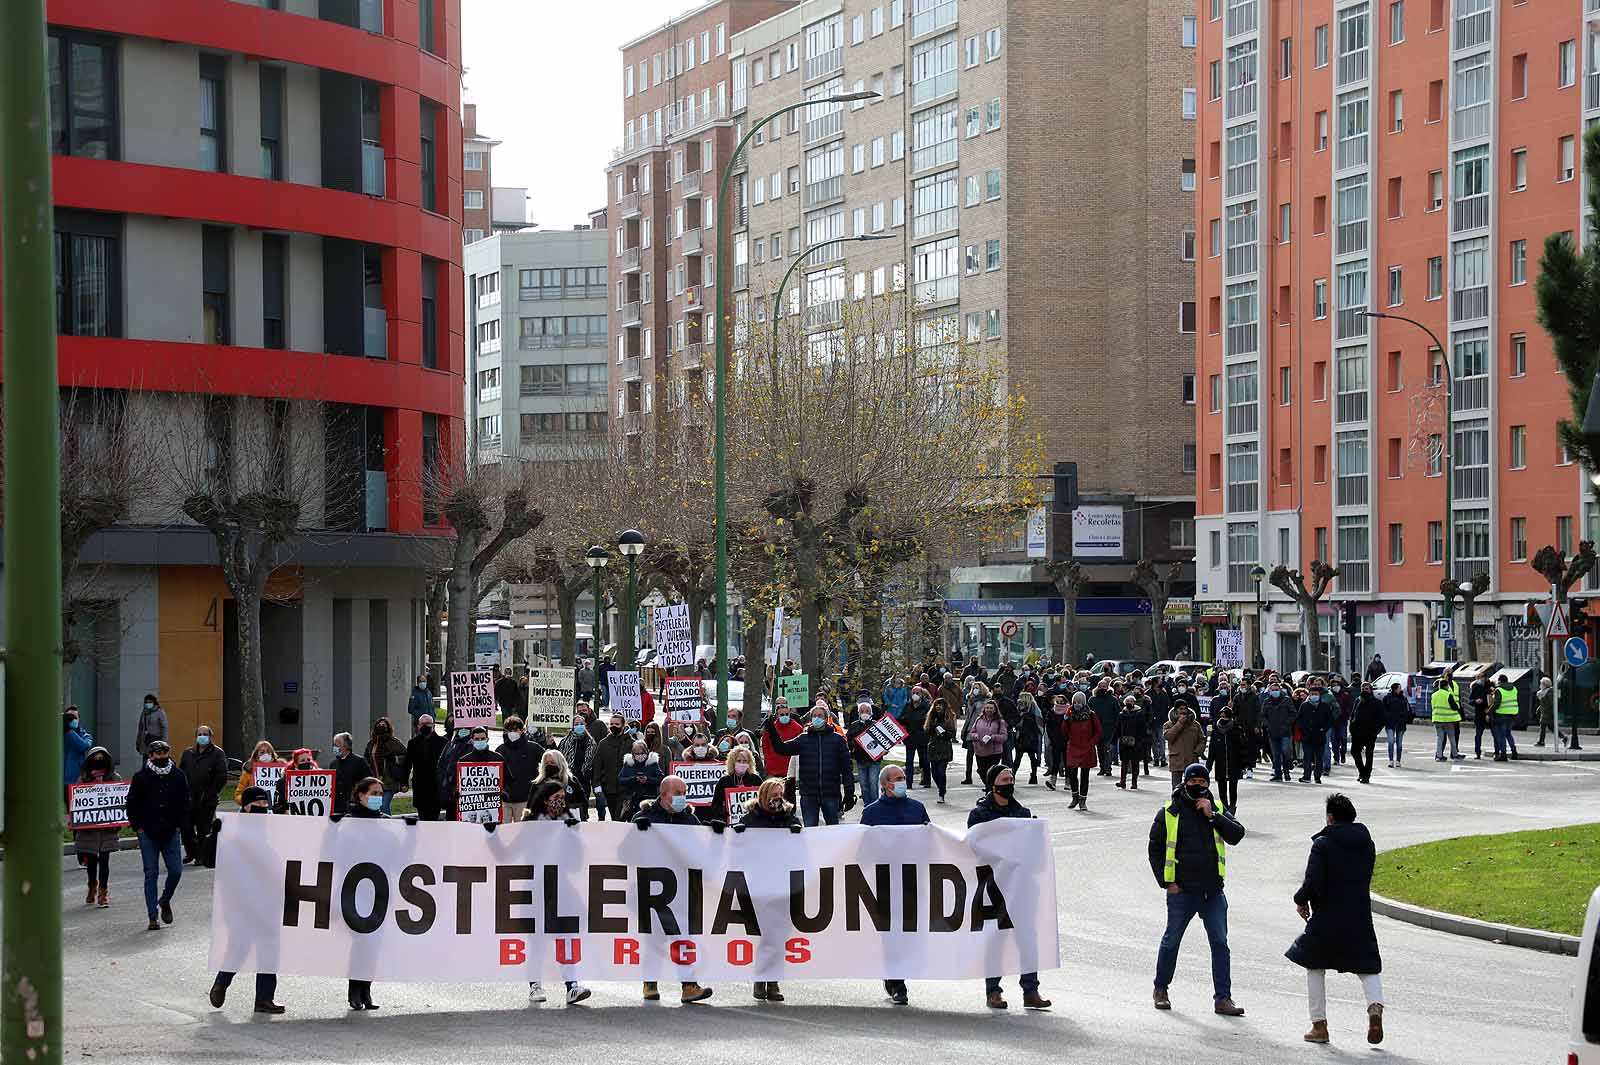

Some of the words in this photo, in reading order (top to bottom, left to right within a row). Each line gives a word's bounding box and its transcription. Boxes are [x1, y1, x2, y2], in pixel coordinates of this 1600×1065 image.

[1088, 518, 1121, 527] Recoletas
[204, 597, 217, 632] 4
[655, 608, 662, 619] SI
[667, 606, 673, 618] A
[678, 605, 687, 617] LA
[655, 617, 689, 631] HOSTELERIA
[656, 631, 664, 643] LA
[658, 641, 691, 656] CAEMOS
[661, 653, 687, 667] TODOS
[453, 673, 468, 686] NO
[470, 672, 491, 685] NOS
[531, 670, 539, 678] NO
[610, 676, 617, 685] EL
[619, 674, 638, 684] PEOR
[533, 687, 573, 697] IMPUESTOS
[614, 685, 639, 697] VIRUS.
[669, 688, 700, 696] CASADO
[454, 697, 466, 707] NO
[466, 696, 492, 707] SOMOS
[621, 699, 631, 708] LOS
[669, 698, 701, 708] DIMISIÓN
[455, 708, 464, 719] EL
[466, 707, 492, 718] VIRUS
[532, 713, 570, 723] INGRESOS
[869, 725, 893, 750] DIMISIÓN
[261, 768, 271, 778] SI
[466, 767, 489, 776] IGEA
[295, 776, 306, 788] SI
[310, 776, 327, 787] NO
[461, 777, 500, 787] CASADO
[75, 798, 95, 807] NOS
[459, 794, 485, 804] MATAN
[289, 798, 325, 816] NO
[459, 801, 501, 812] HOSTELEROS
[283, 860, 762, 936] HOSTELERIA
[789, 863, 1014, 933] UNIDA
[500, 937, 811, 966] BURGOS
